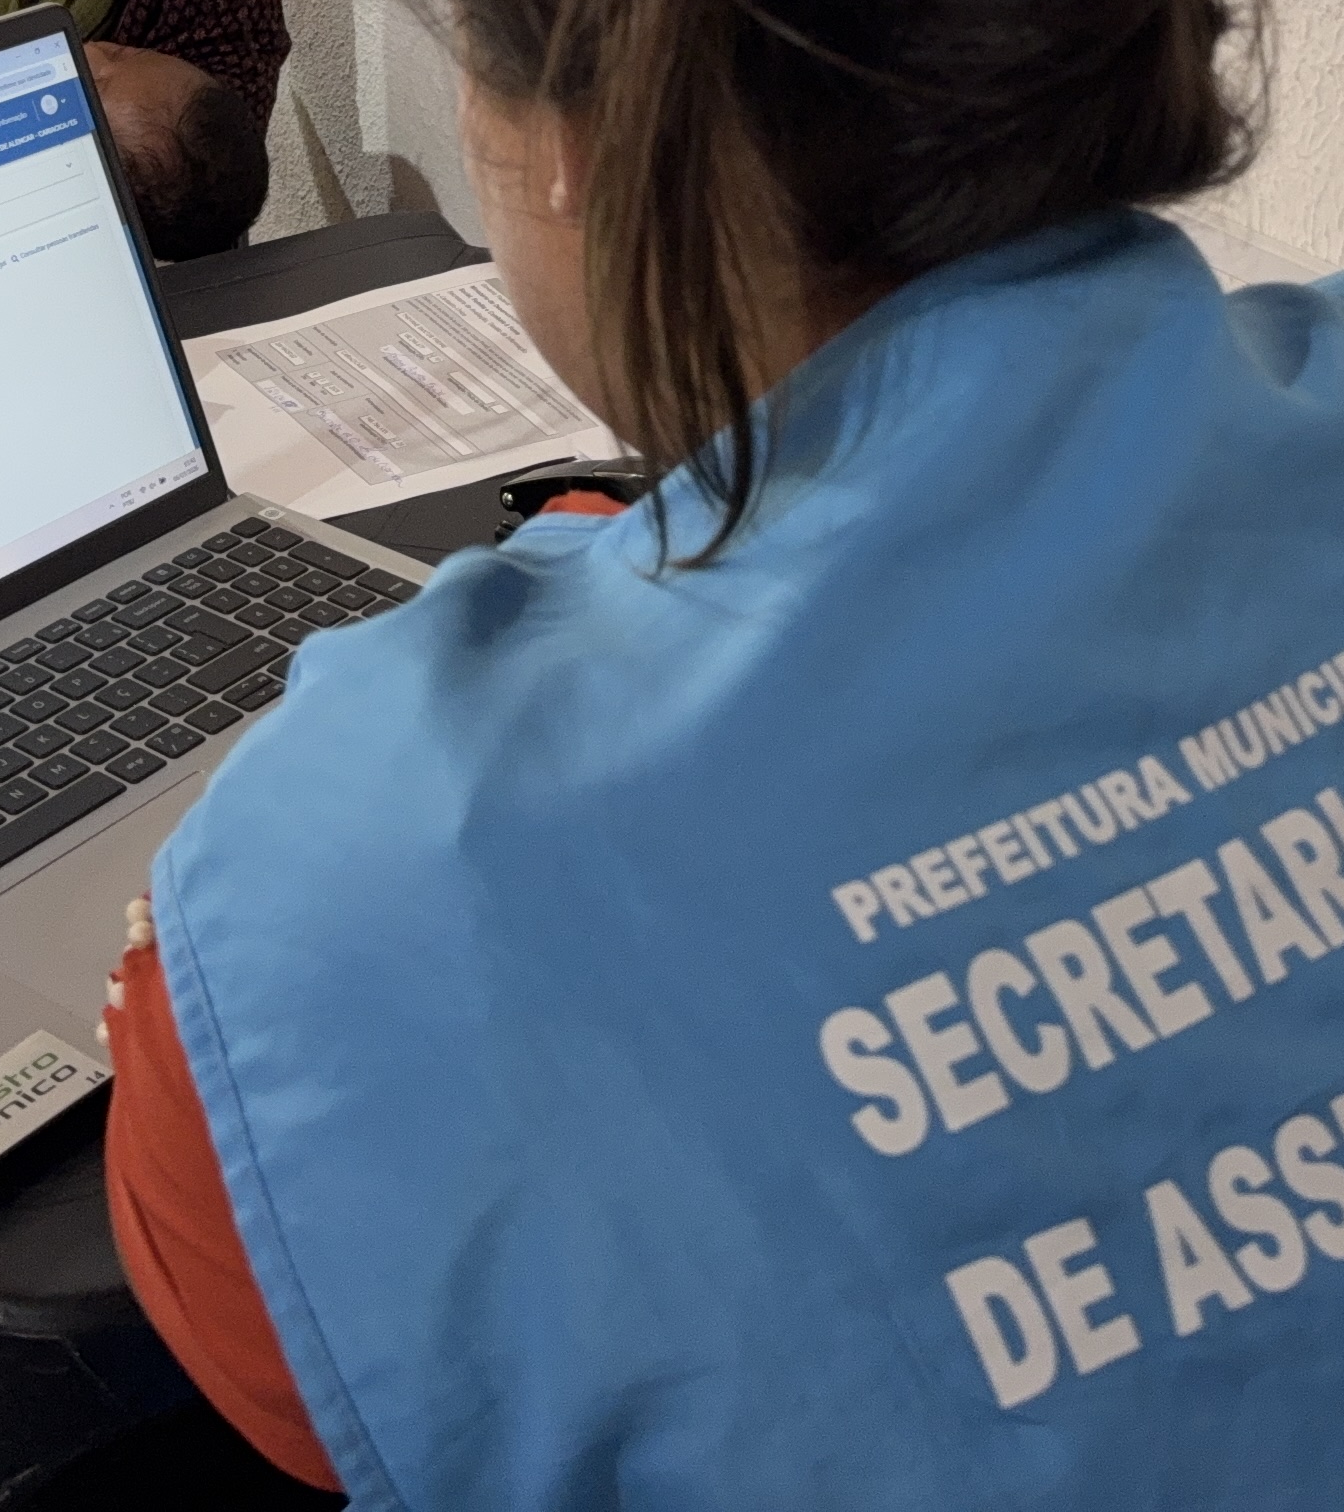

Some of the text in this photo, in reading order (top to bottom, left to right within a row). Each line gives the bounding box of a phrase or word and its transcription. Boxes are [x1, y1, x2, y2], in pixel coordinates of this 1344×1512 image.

[831, 754, 1195, 944] PREFEITURA
[86, 1070, 106, 1085] 14
[945, 1217, 1142, 1410] DE
